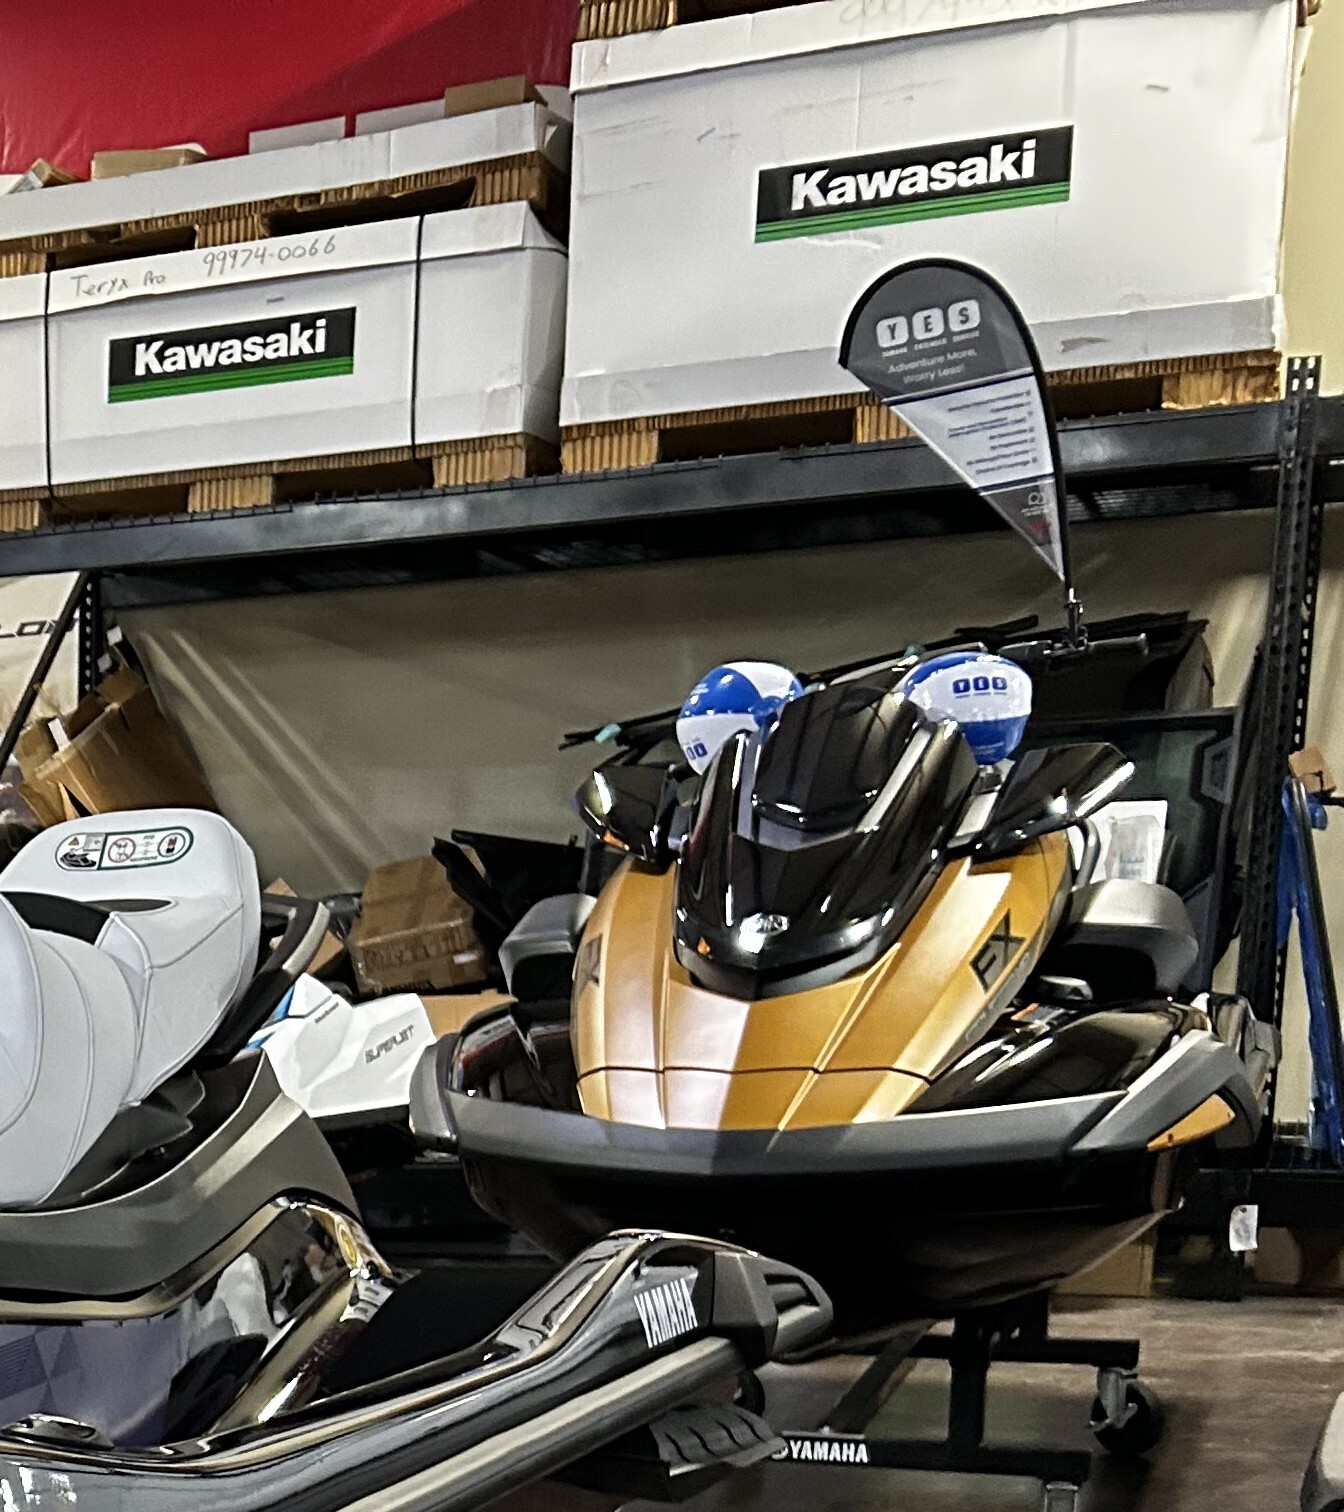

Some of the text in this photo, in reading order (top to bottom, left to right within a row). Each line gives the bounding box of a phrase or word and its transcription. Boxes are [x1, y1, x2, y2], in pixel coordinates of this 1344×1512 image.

[791, 138, 1037, 211] Kawasaki
[71, 234, 337, 297] Teryx Pro 99974-0066
[134, 319, 326, 376] Kawasaki
[632, 1277, 699, 1348] YAMAHA
[790, 1438, 869, 1464] YAMAHA
